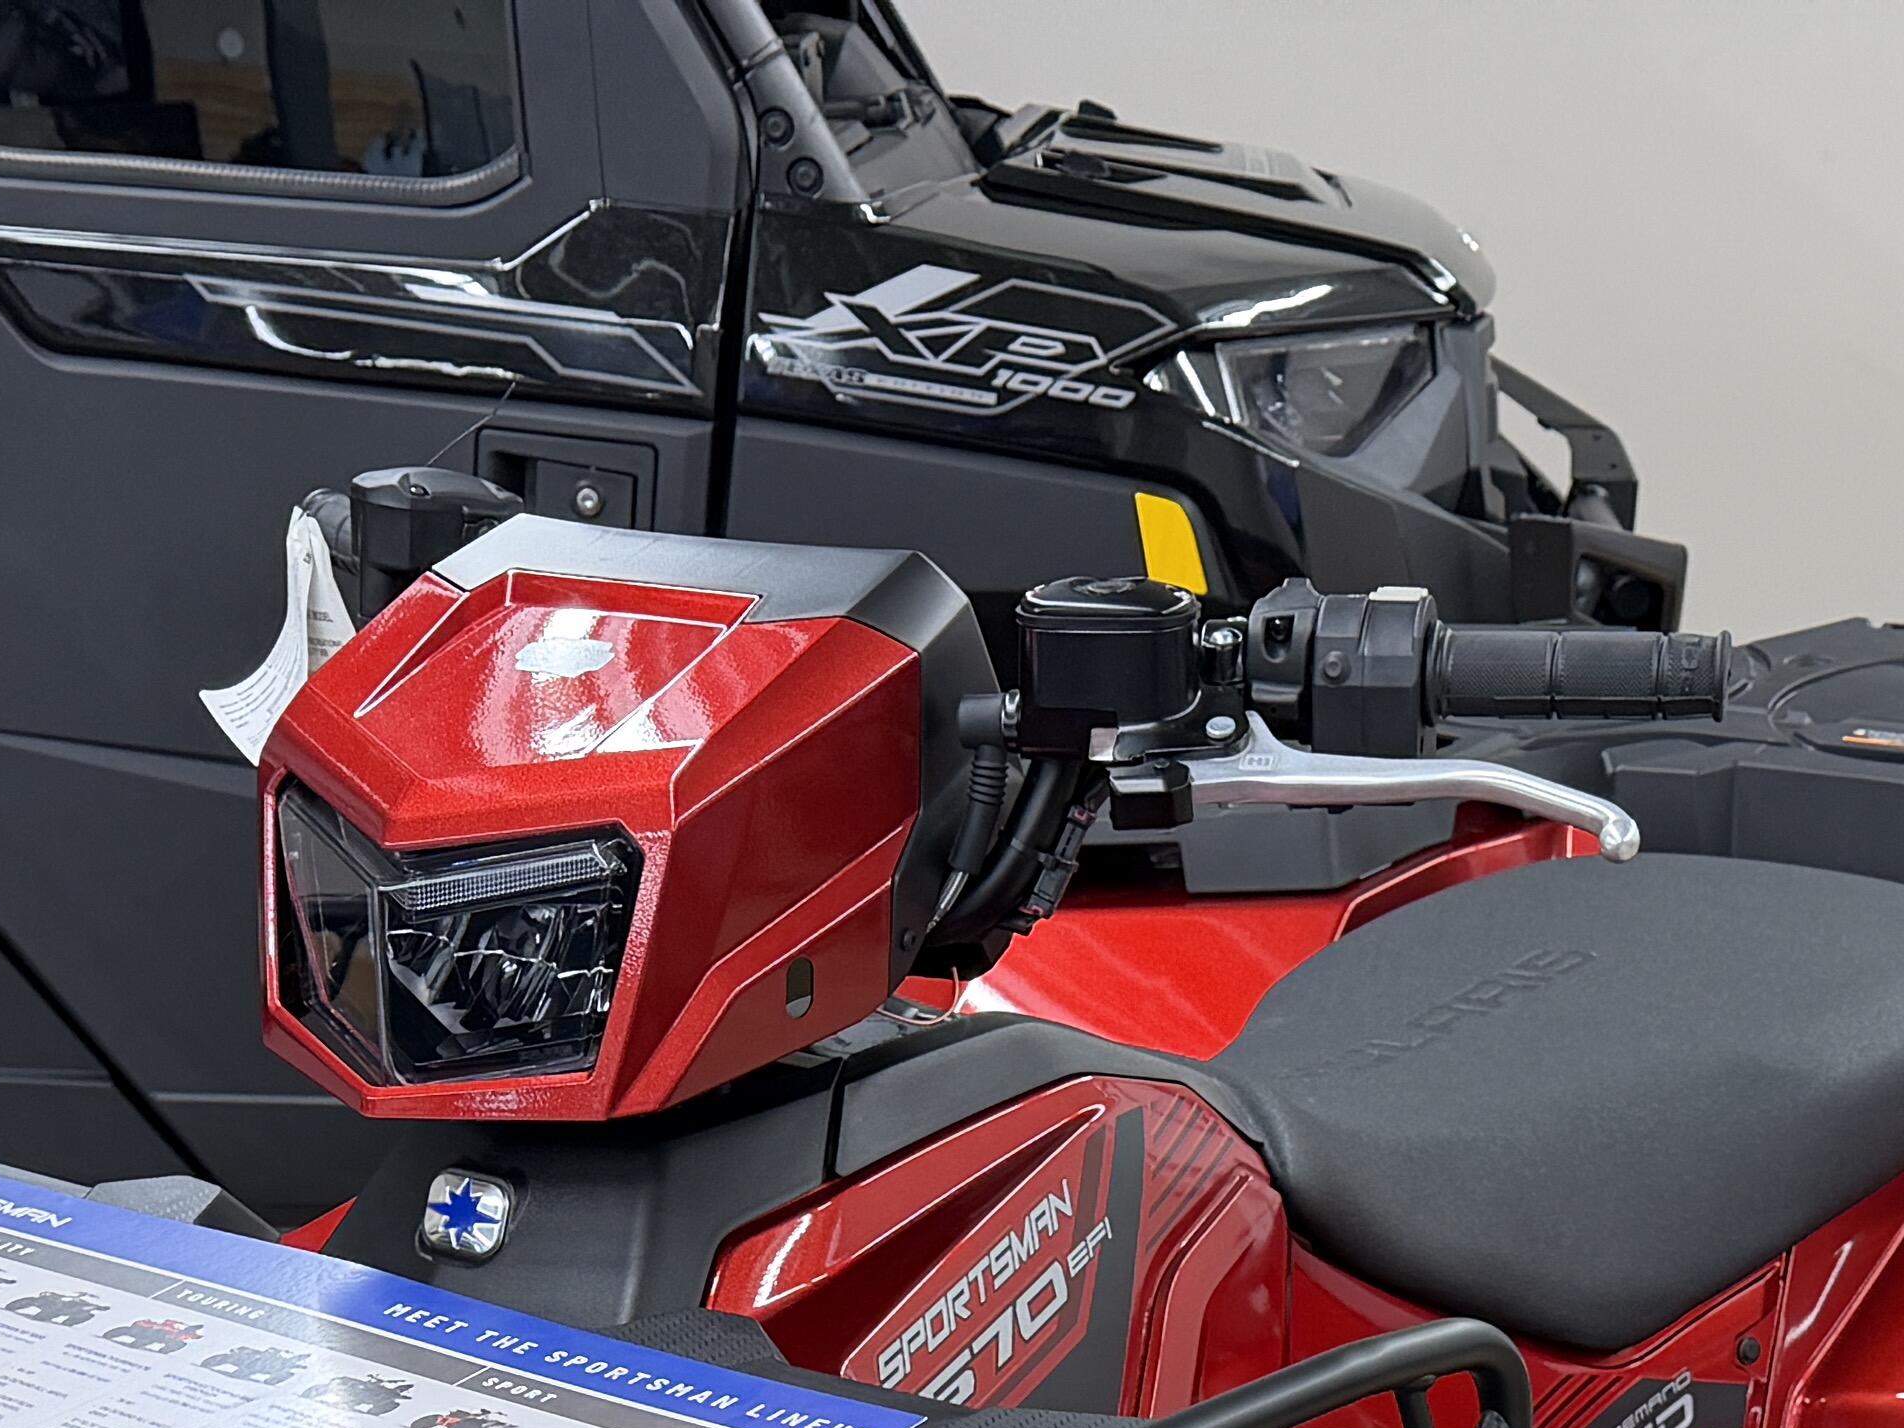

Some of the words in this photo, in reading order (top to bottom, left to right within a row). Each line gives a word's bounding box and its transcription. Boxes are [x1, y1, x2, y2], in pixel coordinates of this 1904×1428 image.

[992, 369, 1136, 409] 1000
[175, 1288, 265, 1321] TOURING
[878, 1177, 1073, 1389] SPORTSMAN
[918, 1260, 1070, 1405] 570
[1068, 1216, 1114, 1277] EFI
[383, 1303, 470, 1335] MEET
[477, 1328, 539, 1356] THE
[544, 1350, 738, 1412] SPORTSMAN
[480, 1376, 559, 1405] SPORT
